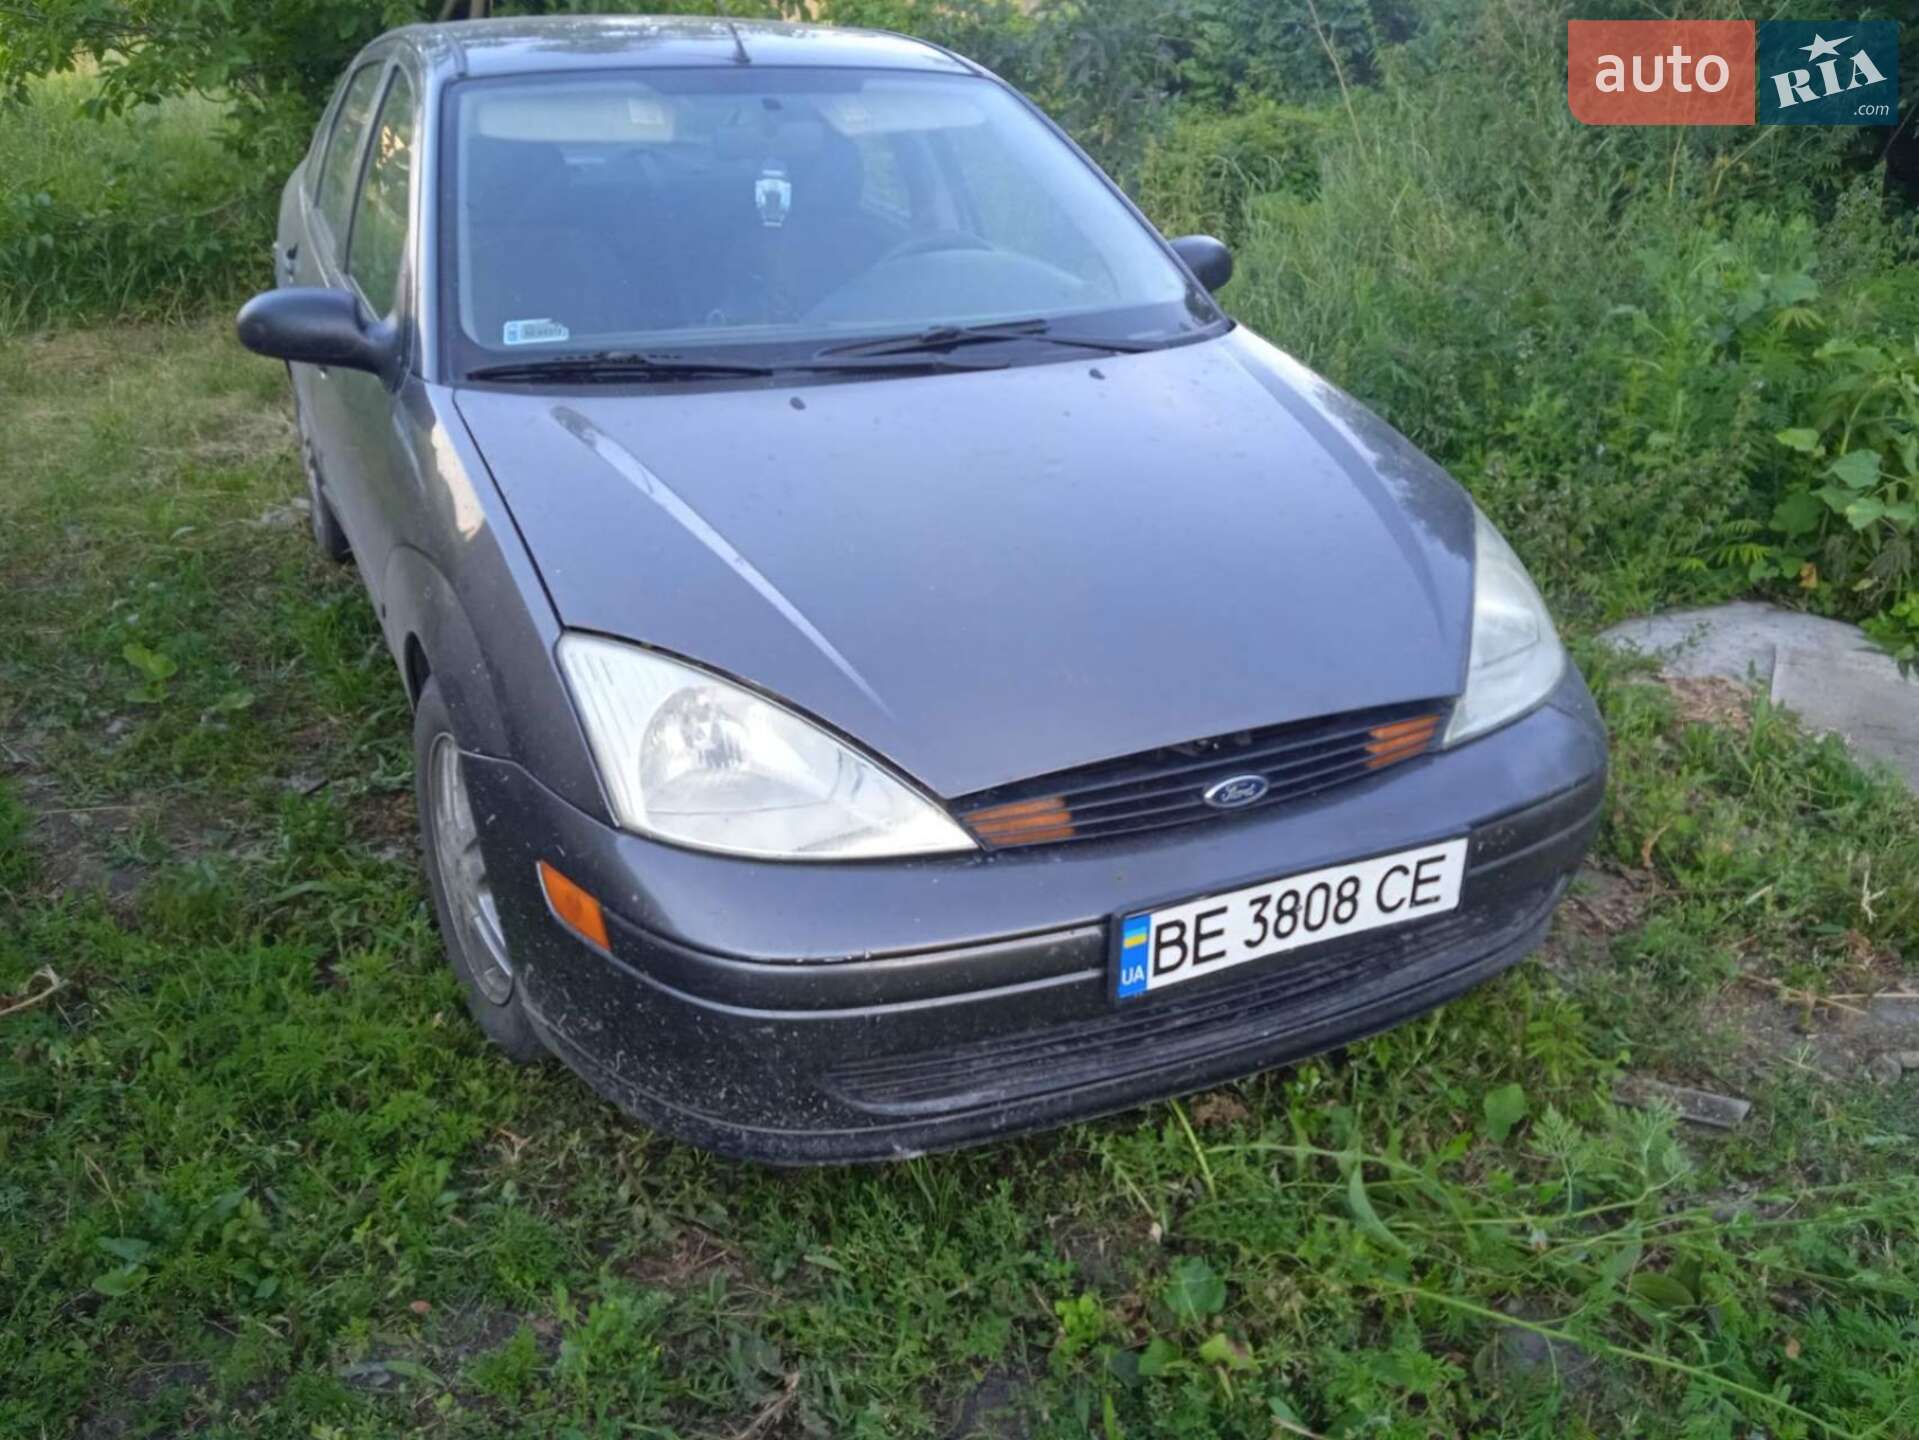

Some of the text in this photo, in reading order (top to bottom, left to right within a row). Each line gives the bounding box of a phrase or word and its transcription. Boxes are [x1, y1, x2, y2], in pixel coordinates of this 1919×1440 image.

[1152, 854, 1447, 977] BE 3808 CE
[1121, 964, 1145, 986] UA
